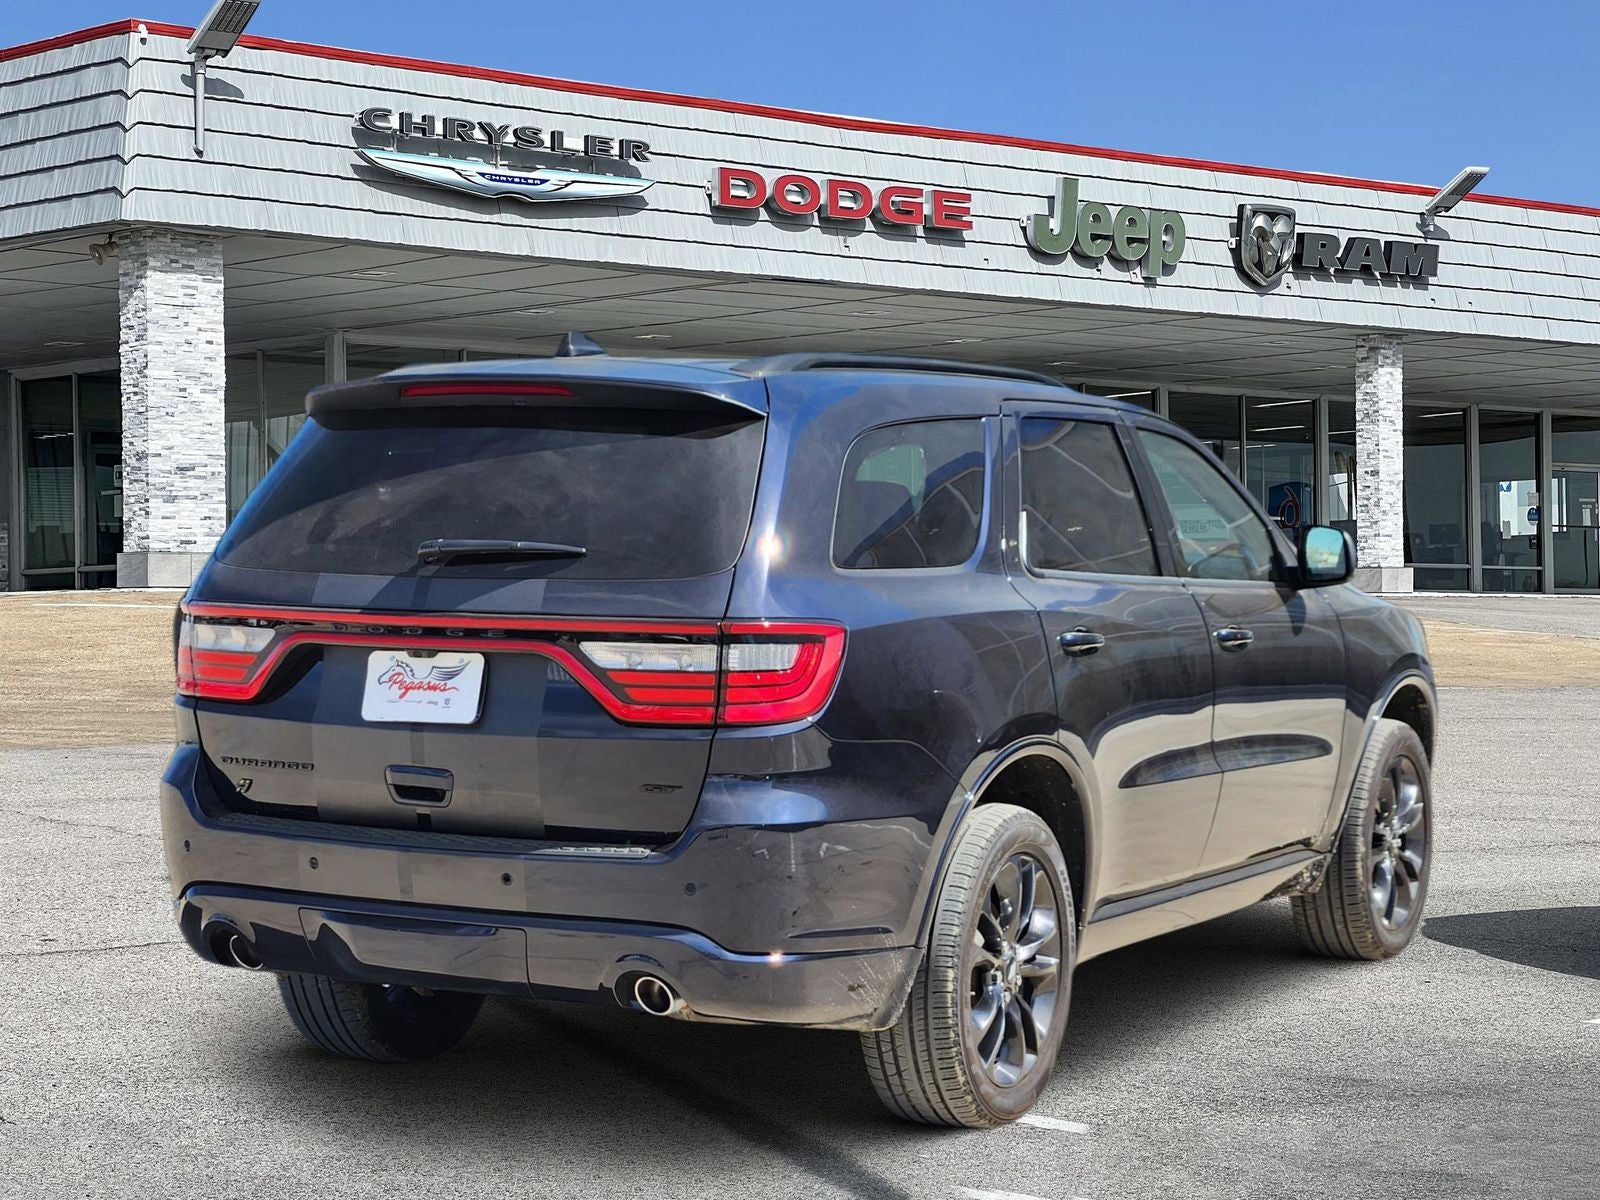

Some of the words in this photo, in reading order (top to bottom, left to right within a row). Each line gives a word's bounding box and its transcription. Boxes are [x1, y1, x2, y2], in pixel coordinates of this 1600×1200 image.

[357, 106, 651, 163] CHRYSLER
[484, 174, 541, 185] CHRYSLER
[711, 166, 974, 231] DODGE
[1025, 177, 1187, 279] Jeep
[1297, 232, 1439, 277] RAM
[388, 671, 459, 700] Pegasus
